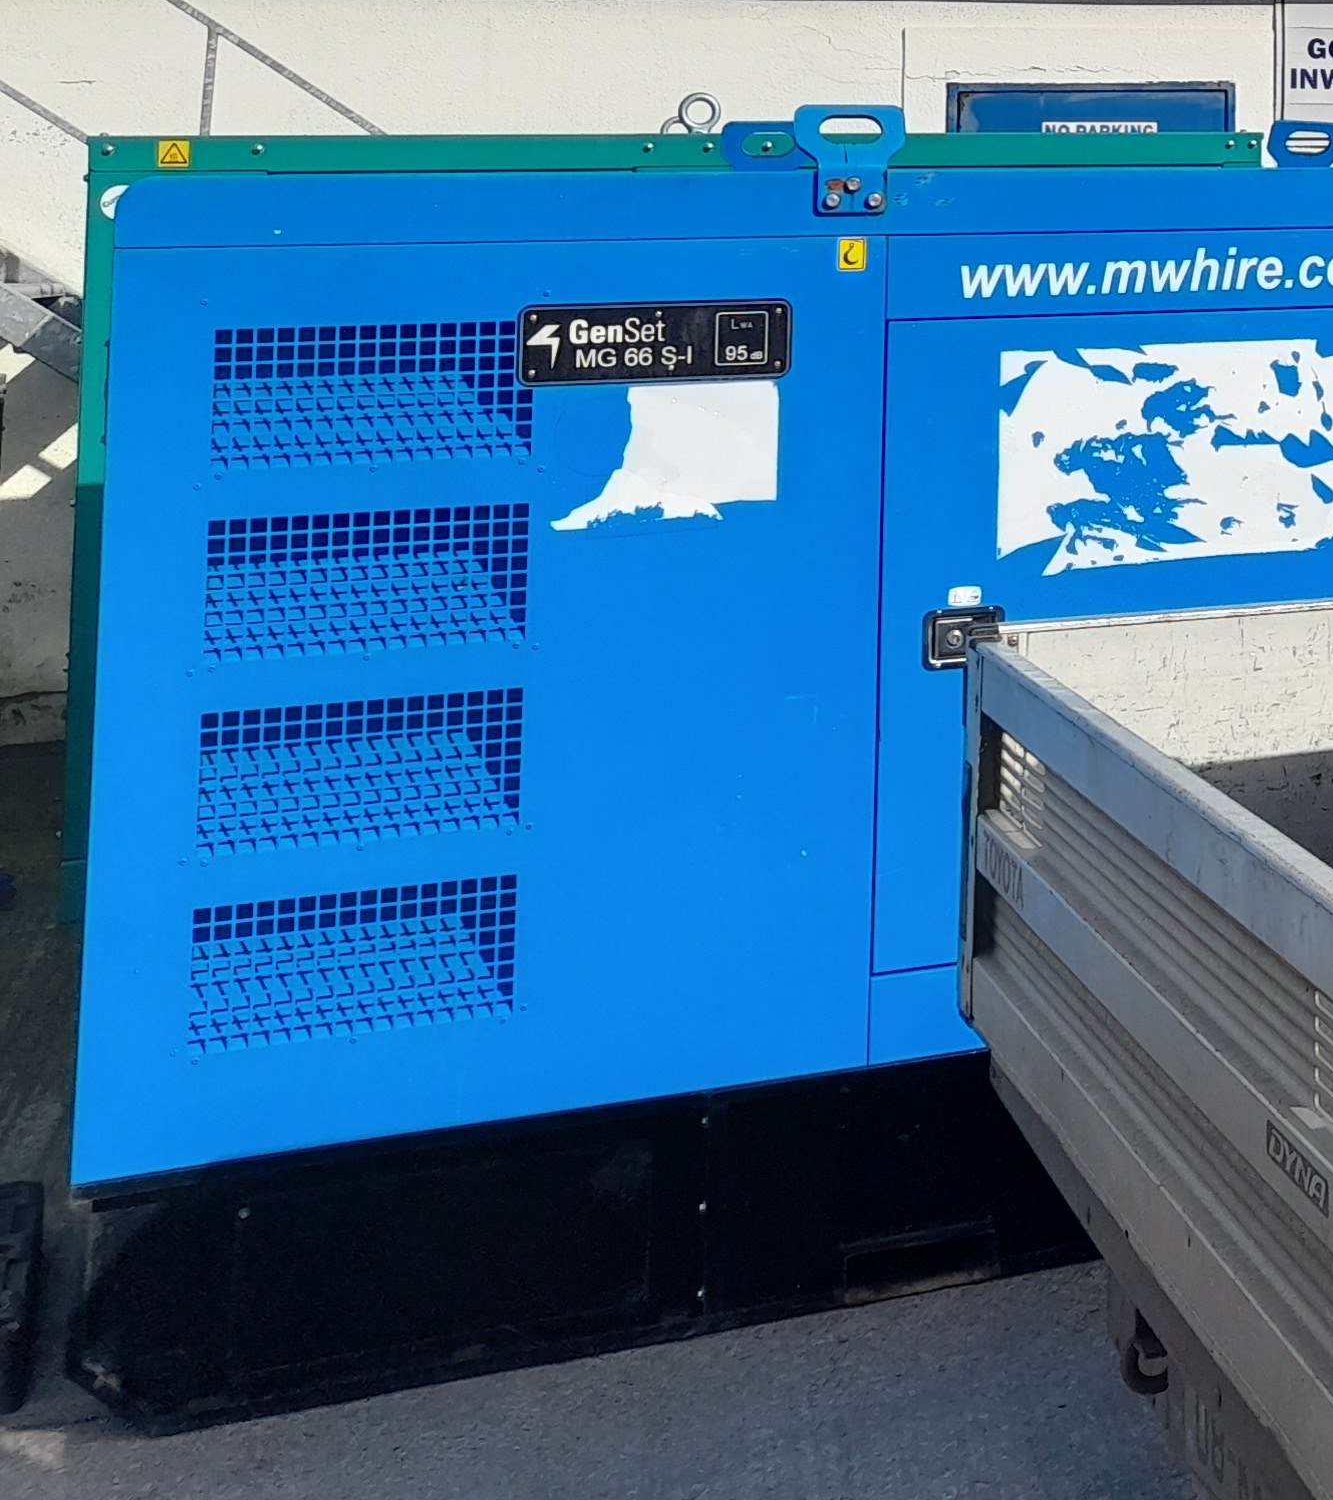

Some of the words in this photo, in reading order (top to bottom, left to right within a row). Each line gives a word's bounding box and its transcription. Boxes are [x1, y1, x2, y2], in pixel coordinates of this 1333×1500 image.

[569, 318, 666, 344] GenSet
[575, 349, 617, 368] MG
[624, 348, 653, 367] 66
[726, 345, 748, 361] 95
[1268, 1128, 1326, 1209] DYNA
